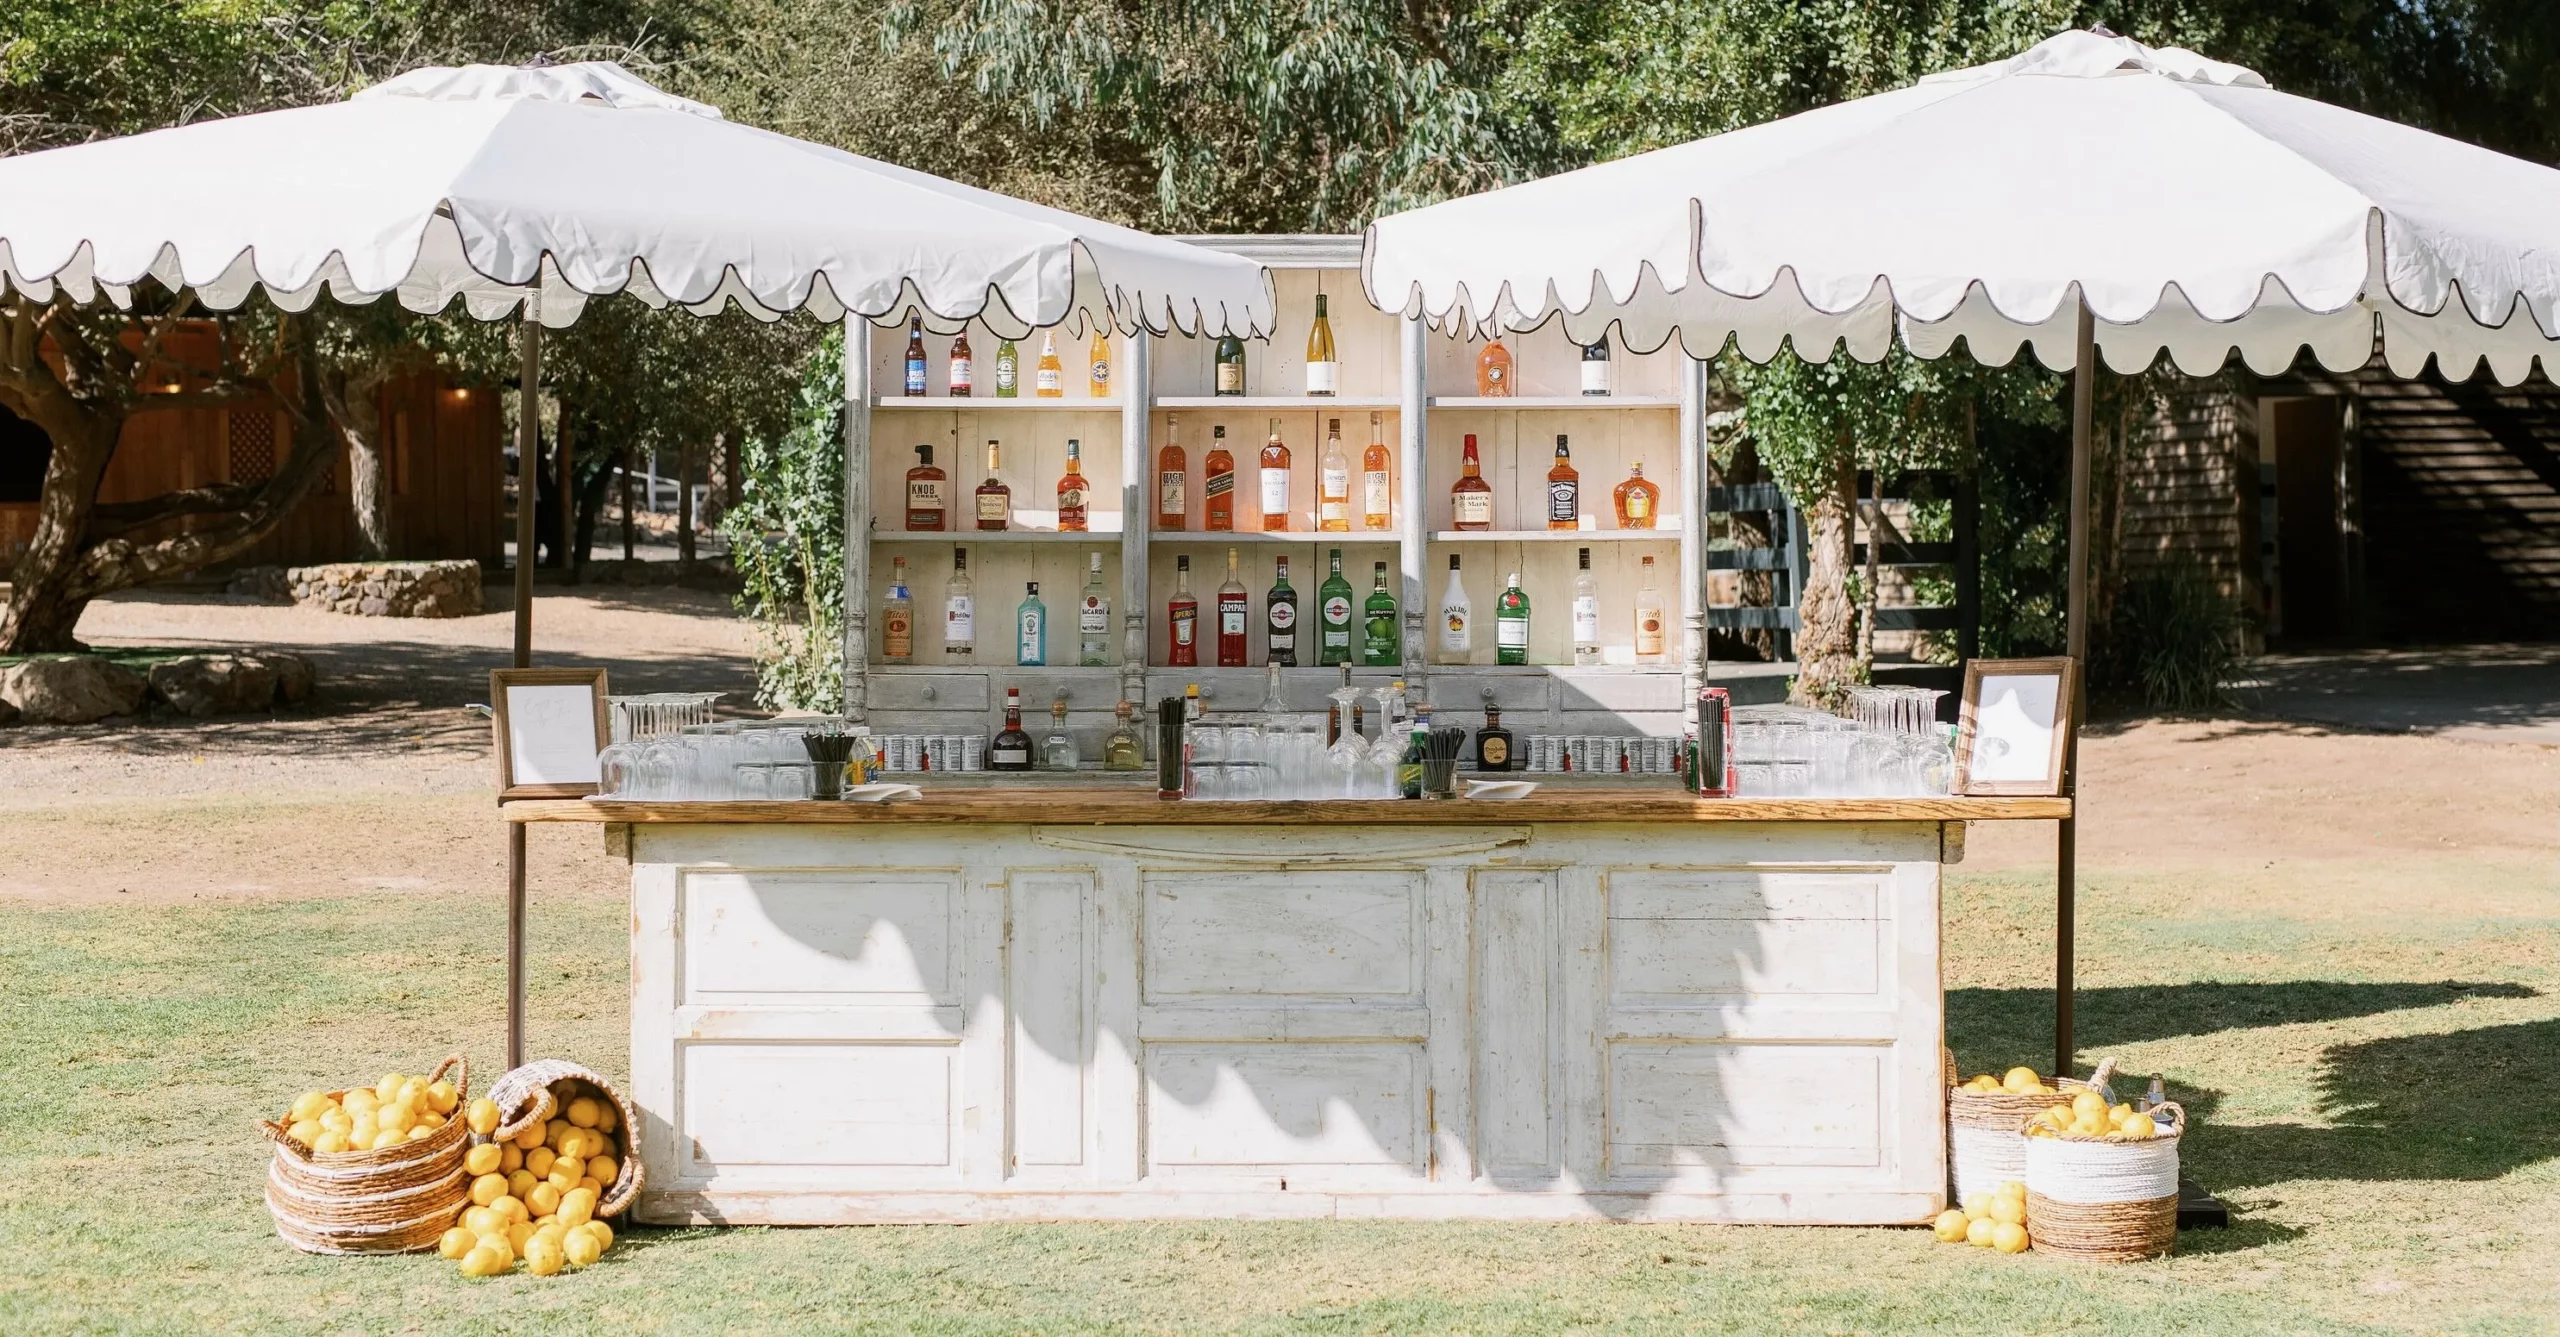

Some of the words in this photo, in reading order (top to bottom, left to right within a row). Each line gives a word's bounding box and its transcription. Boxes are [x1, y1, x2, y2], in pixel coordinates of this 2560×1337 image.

[1163, 472, 1184, 480] HIGH
[1366, 472, 1387, 480] HIGH
[911, 483, 935, 495] KNOB
[886, 610, 909, 619] Tito's
[1443, 605, 1468, 617] MALIBU
[1640, 608, 1661, 619] Tito's
